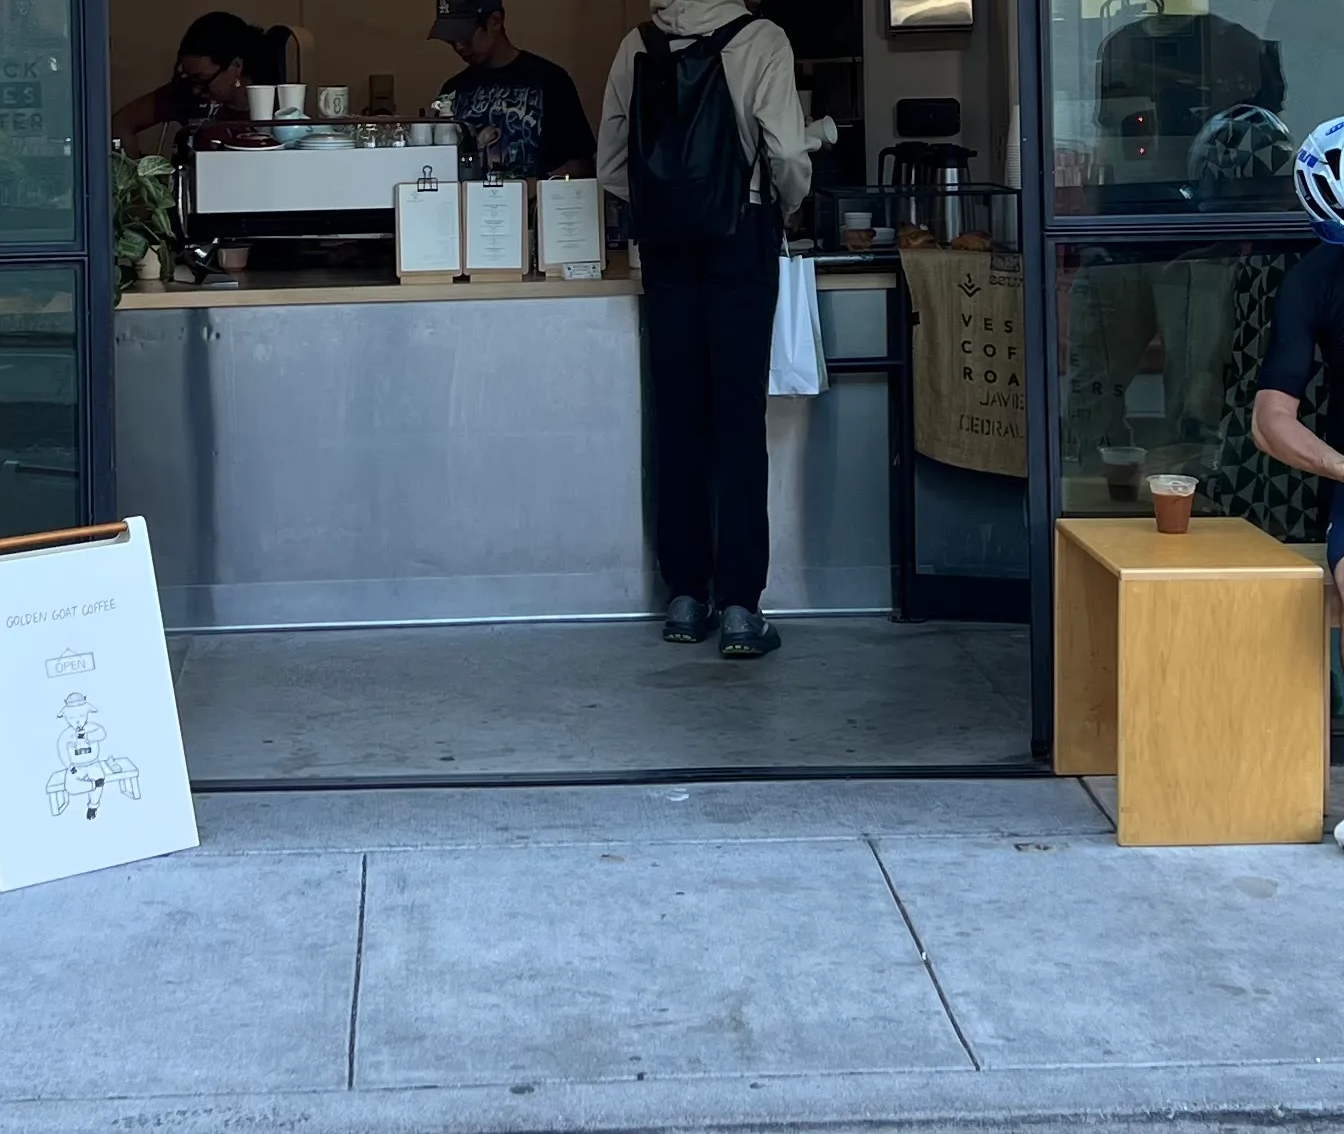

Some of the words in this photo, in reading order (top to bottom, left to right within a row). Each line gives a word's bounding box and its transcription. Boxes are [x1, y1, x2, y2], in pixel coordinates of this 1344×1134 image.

[7, 612, 47, 628] GOLDEN
[52, 606, 77, 621] GOAT
[82, 599, 116, 616] COFFEE
[55, 660, 85, 673] OPEN
